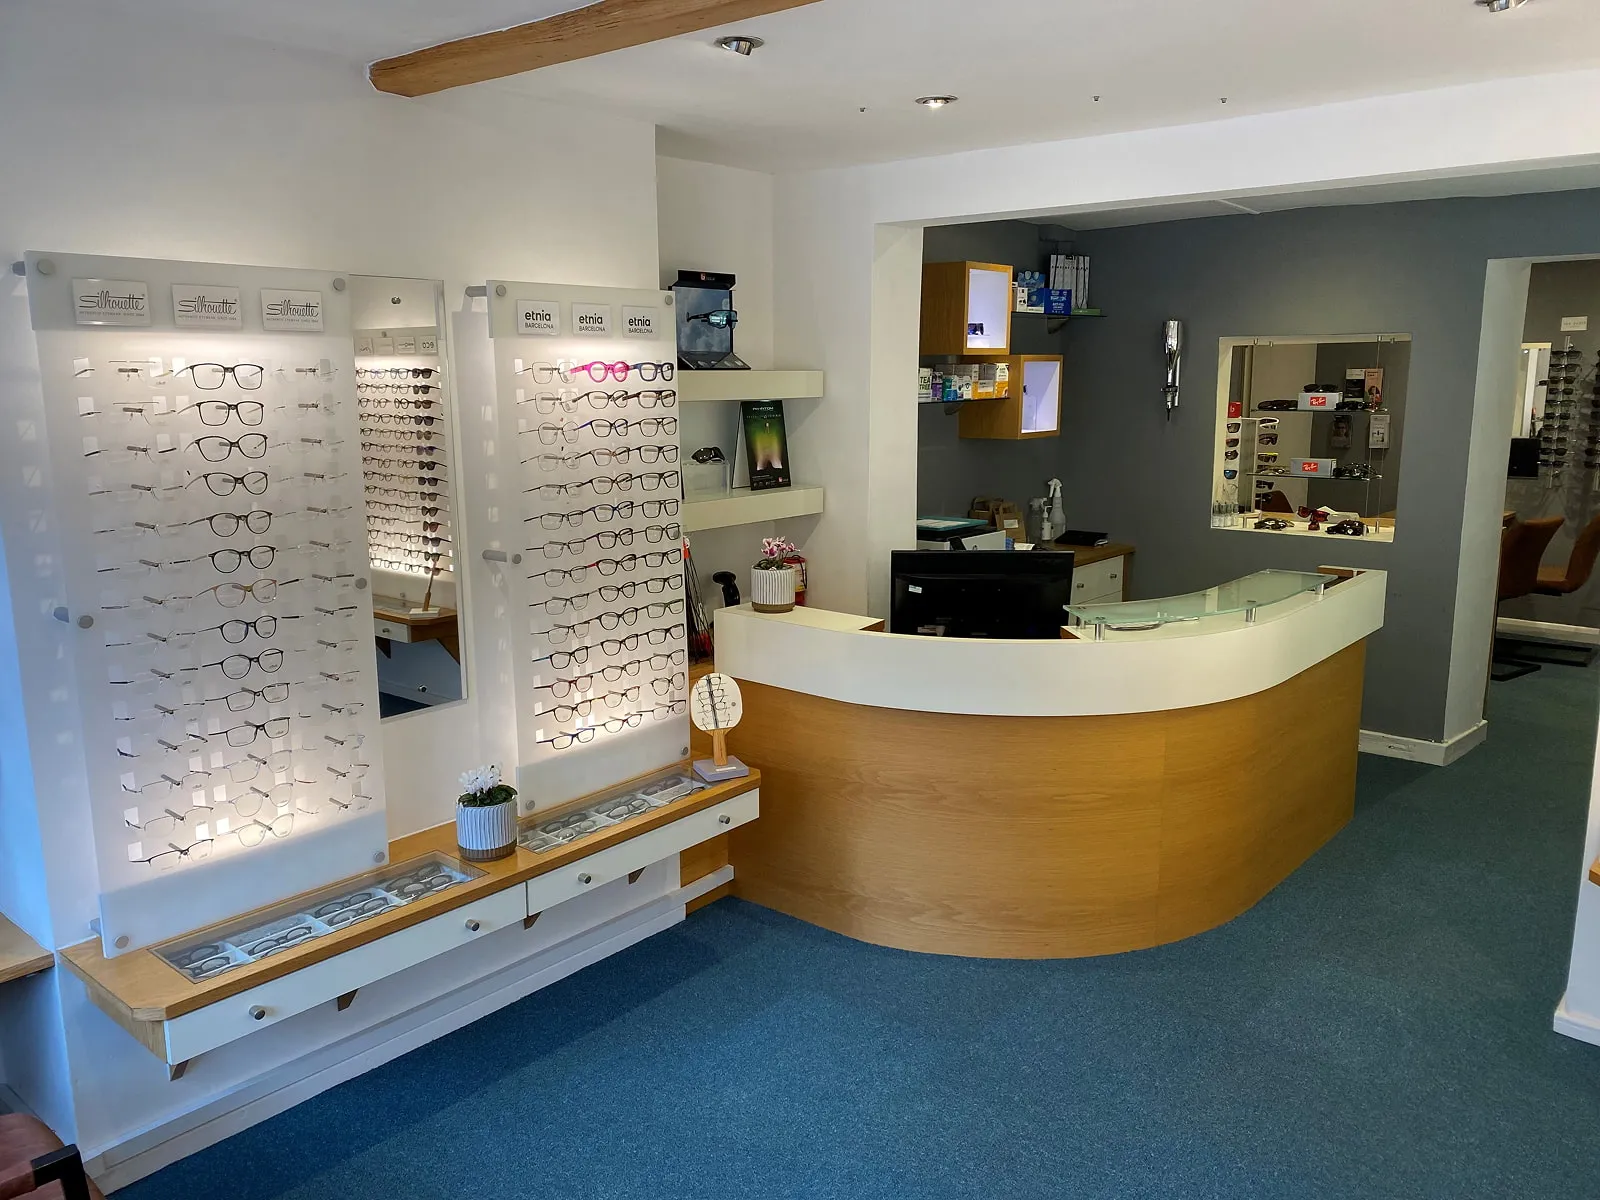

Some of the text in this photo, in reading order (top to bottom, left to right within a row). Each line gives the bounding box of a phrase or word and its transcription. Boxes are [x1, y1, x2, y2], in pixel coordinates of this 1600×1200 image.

[78, 290, 145, 311] Silhouette
[178, 295, 237, 315] Silhouette
[266, 299, 319, 317] Silhouette
[525, 309, 552, 321] etnia
[578, 312, 603, 325] etnia
[628, 315, 651, 327] etnia
[919, 376, 931, 384] TEA
